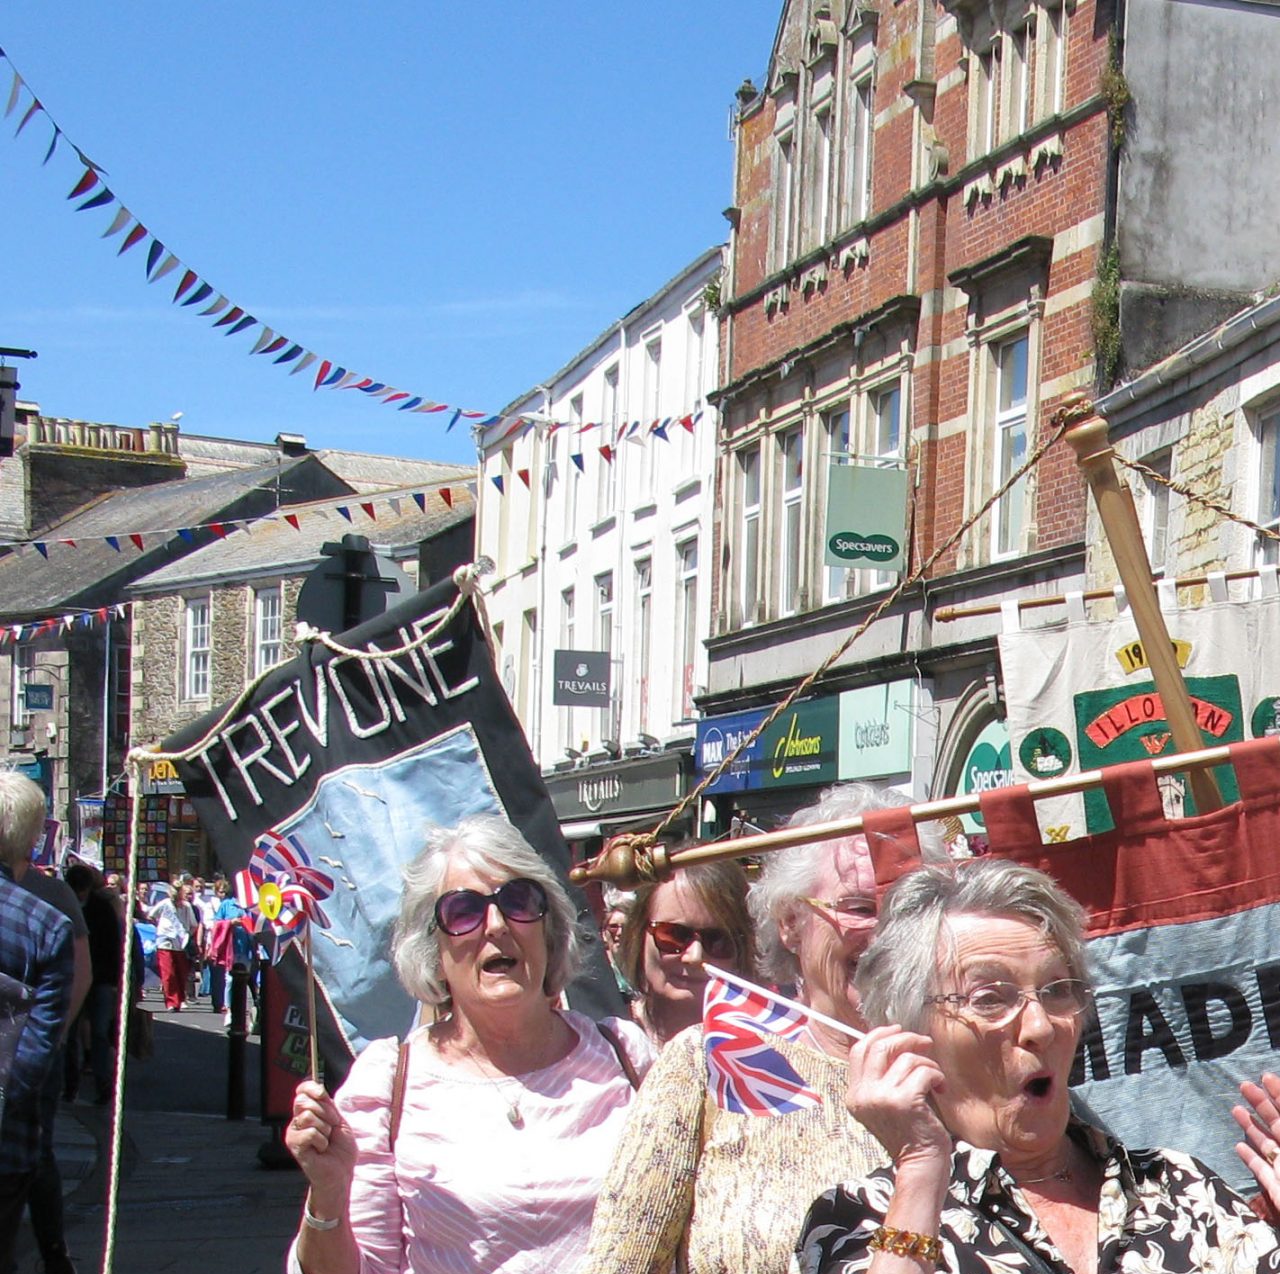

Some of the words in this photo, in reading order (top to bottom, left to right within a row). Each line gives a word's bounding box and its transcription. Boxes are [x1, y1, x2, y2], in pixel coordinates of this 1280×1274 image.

[835, 538, 893, 554] Specsavers
[558, 680, 607, 694] TREVAILS
[185, 606, 480, 821] TREVONE
[703, 740, 723, 763] MAX
[773, 712, 821, 778] Johnsons
